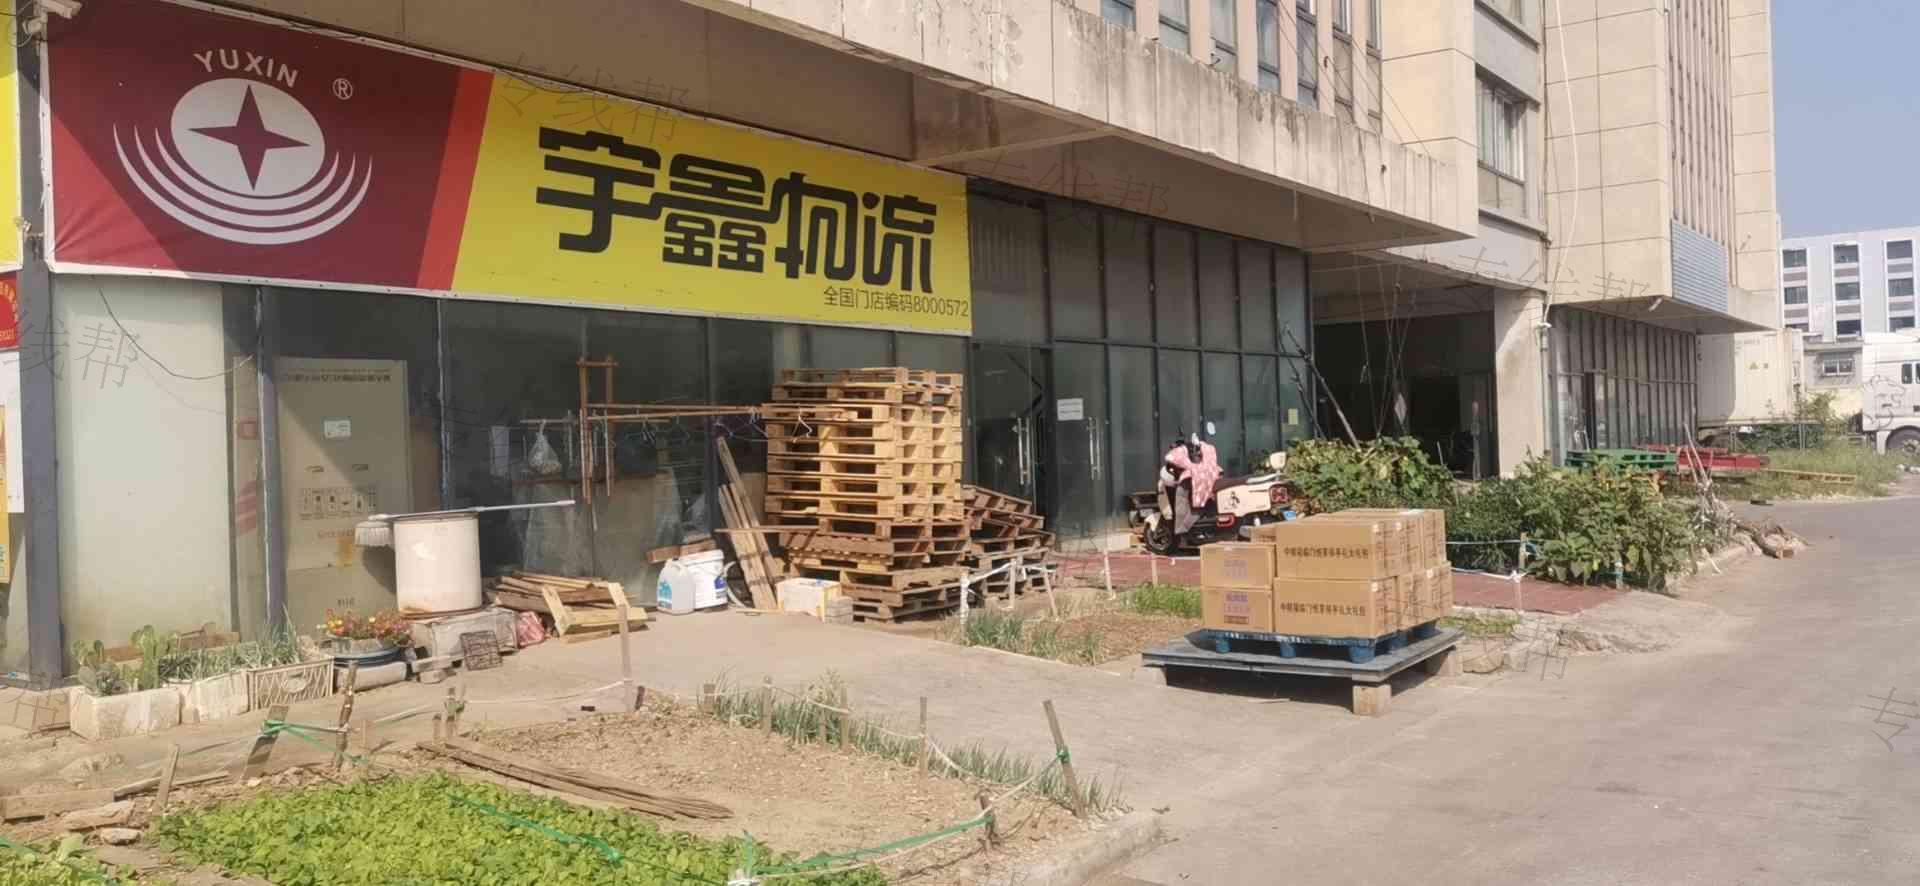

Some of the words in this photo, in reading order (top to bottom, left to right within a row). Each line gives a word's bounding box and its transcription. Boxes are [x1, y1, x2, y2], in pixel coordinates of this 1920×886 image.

[193, 49, 299, 88] YUXIN
[535, 125, 938, 295] 宇鑫物流
[823, 285, 969, 317] 全国门店编码8000572
